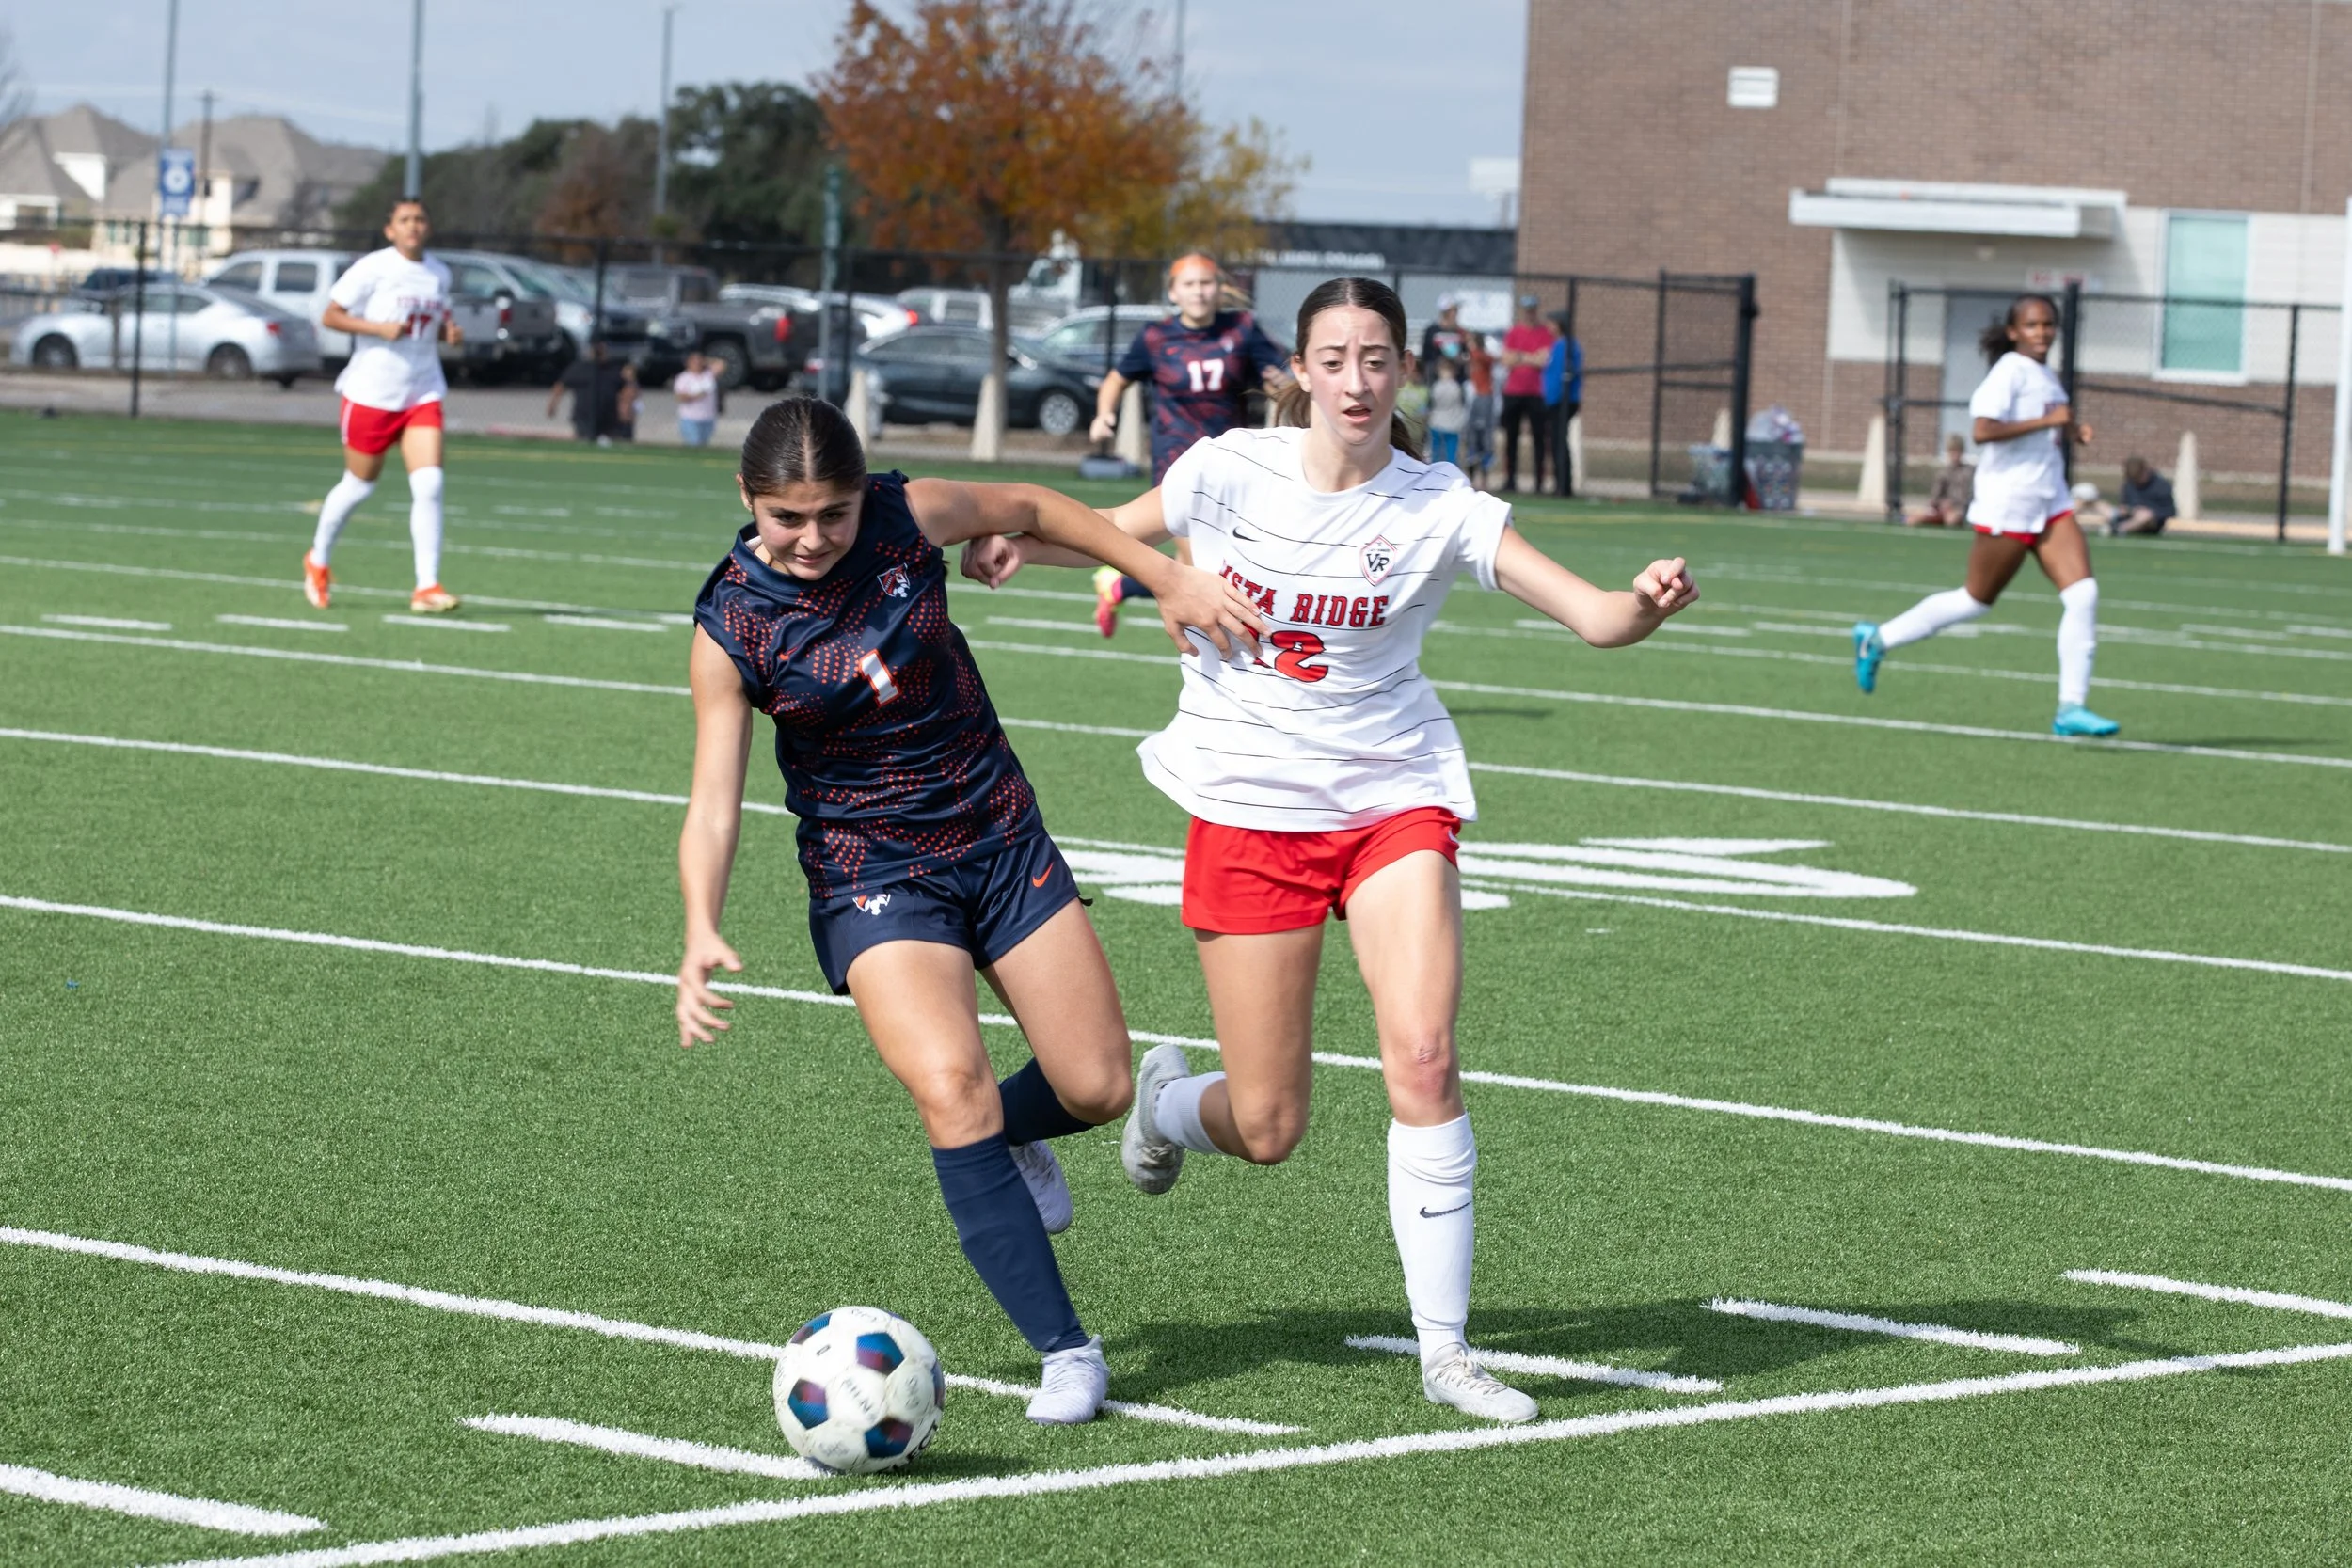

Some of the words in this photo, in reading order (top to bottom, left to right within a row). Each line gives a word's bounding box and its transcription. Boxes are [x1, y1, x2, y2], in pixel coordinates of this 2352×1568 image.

[1187, 358, 1224, 392] 17
[1366, 553, 1390, 572] VR
[1219, 561, 1277, 617] ISTA
[1289, 593, 1390, 628] RIDGE
[859, 648, 901, 706] 1
